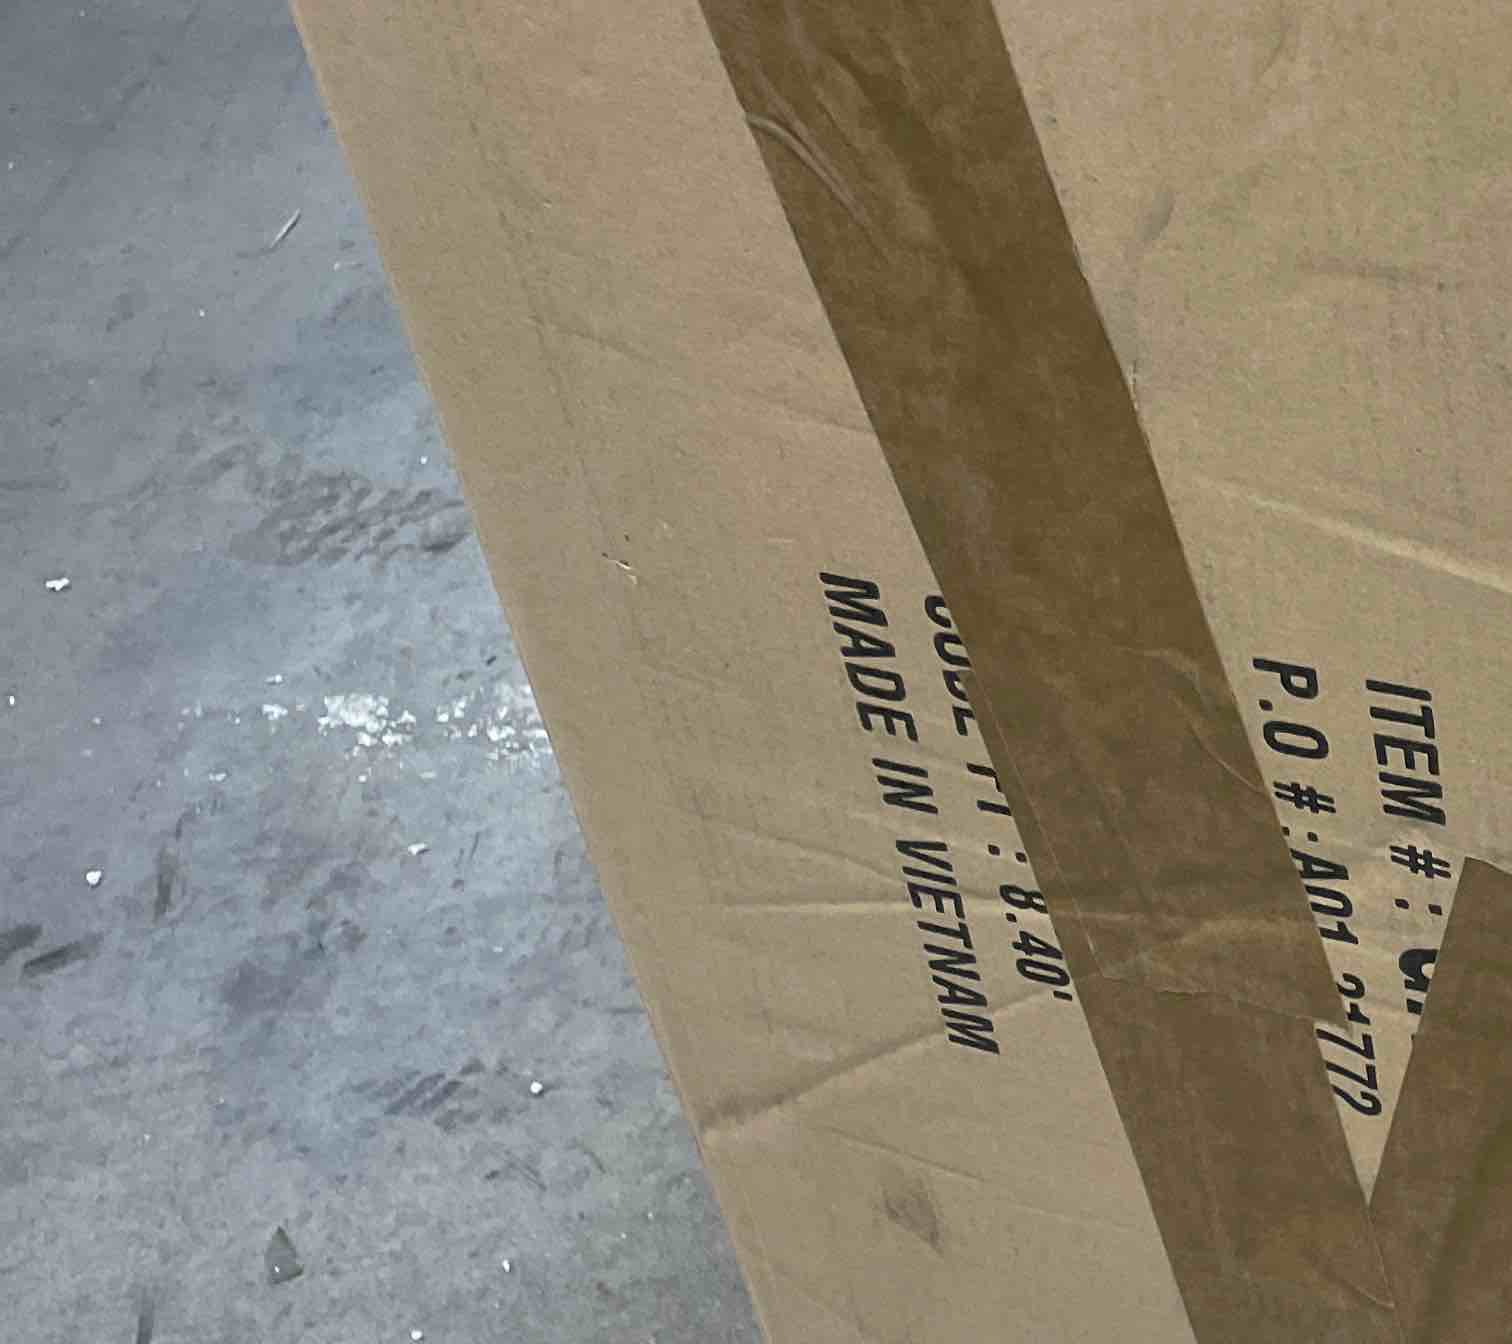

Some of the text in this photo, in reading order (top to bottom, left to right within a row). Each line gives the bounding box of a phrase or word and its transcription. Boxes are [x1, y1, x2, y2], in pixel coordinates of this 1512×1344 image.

[818, 571, 919, 743] MADE
[1251, 657, 1330, 760] P.O
[871, 757, 939, 815] IN
[1365, 678, 1447, 827] ITEM
[894, 839, 1001, 1055] VIETNAM
